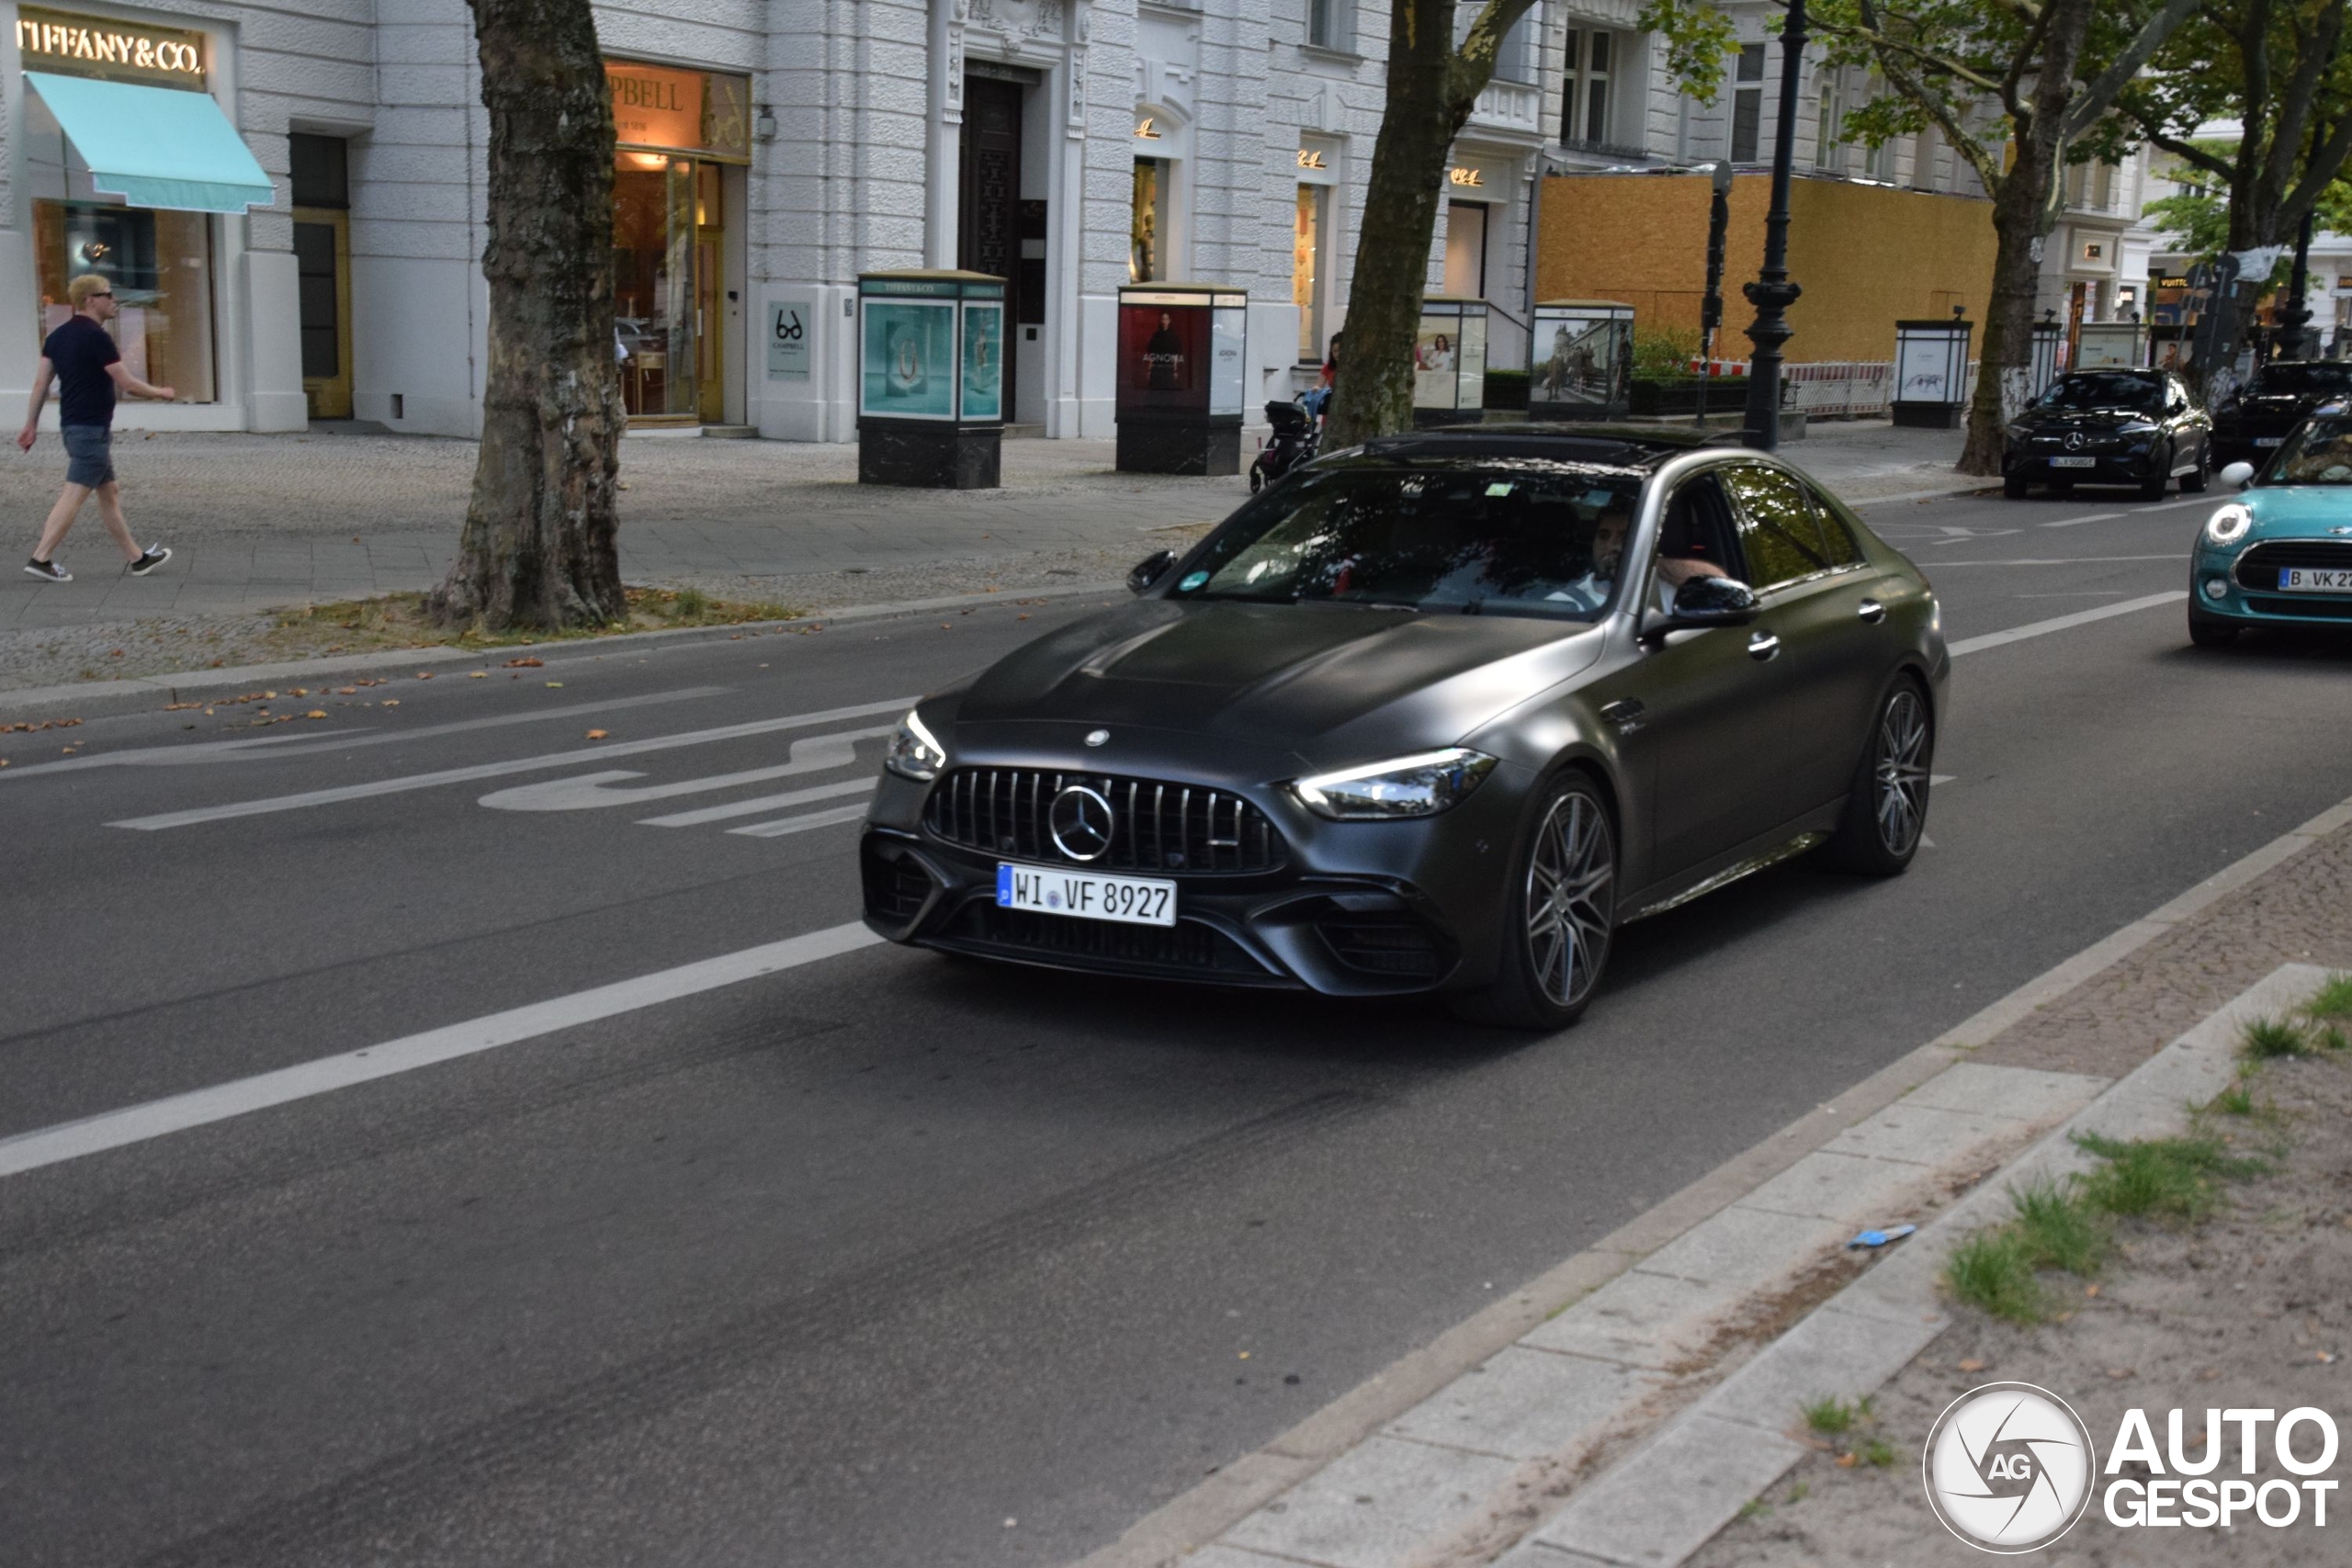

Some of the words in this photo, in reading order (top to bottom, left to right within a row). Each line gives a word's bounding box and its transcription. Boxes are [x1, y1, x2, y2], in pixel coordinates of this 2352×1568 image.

[609, 75, 684, 112] PBELL
[772, 341, 804, 350] CAMPBELL
[1143, 353, 1184, 363] AGNONA
[2290, 570, 2301, 587] B
[2312, 571, 2334, 587] VK
[1015, 873, 1043, 906] WI
[1064, 879, 1096, 911] VF
[1103, 882, 1169, 919] 8927
